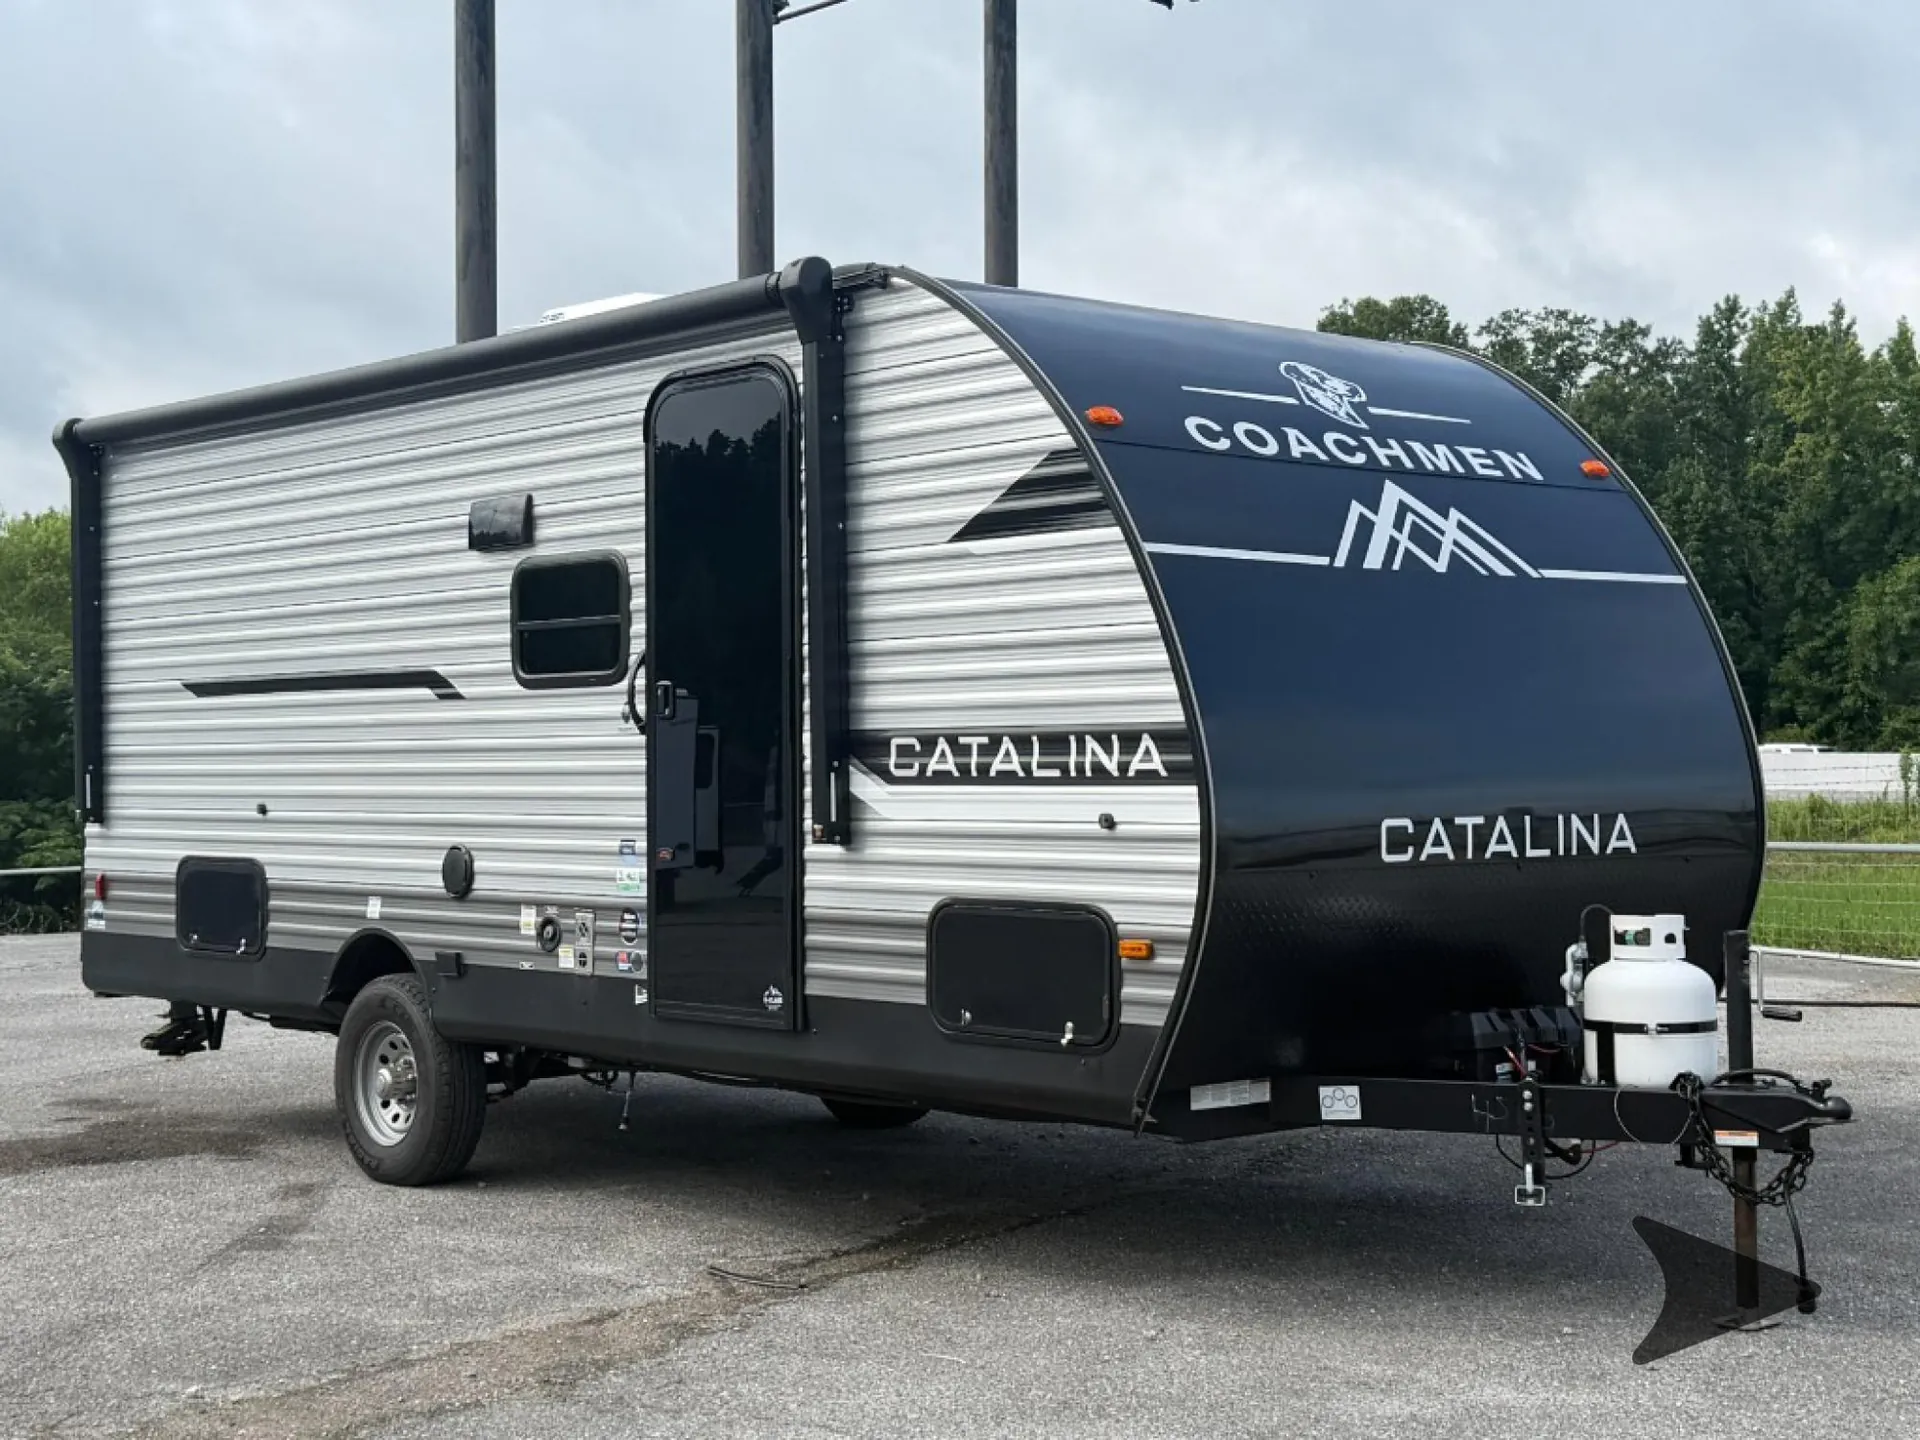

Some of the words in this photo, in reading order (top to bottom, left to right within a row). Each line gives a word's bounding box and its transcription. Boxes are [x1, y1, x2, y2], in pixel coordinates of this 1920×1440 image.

[1184, 415, 1544, 481] COACHMEN
[888, 733, 1168, 777] CATALINA
[1380, 812, 1638, 863] CATALINA
